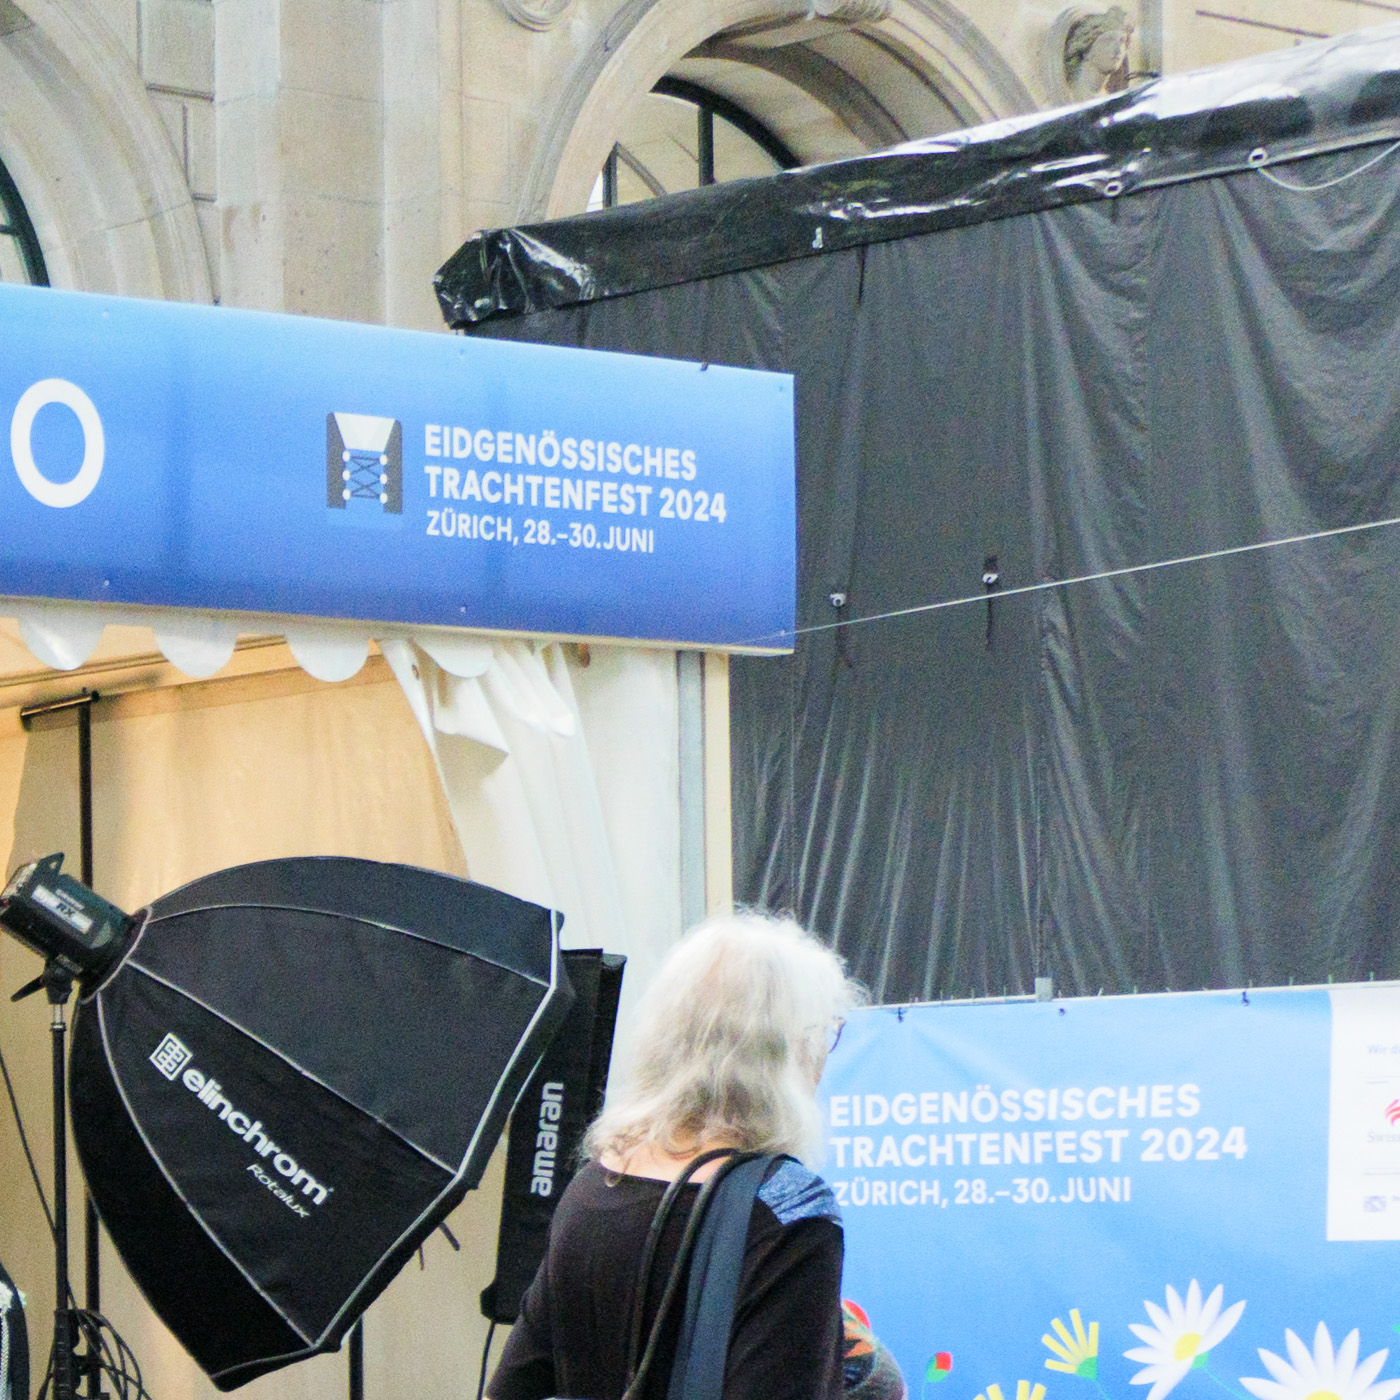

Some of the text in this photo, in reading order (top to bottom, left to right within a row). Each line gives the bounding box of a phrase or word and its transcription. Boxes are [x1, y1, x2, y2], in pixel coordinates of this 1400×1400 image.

[423, 423, 698, 482] EIDGENÖSSISCHES
[423, 465, 727, 524] TRACHTENFEST 2024
[425, 507, 519, 547] ZÜRICH,
[829, 1083, 1201, 1128] EIDGENÖSSISCHES
[182, 1068, 330, 1206] elinchrom
[530, 1082, 565, 1197] amaran
[828, 1125, 1248, 1169] TRACHTENFEST 2024
[246, 1163, 311, 1218] Rotalux
[832, 1176, 949, 1209] ZÜRICH,
